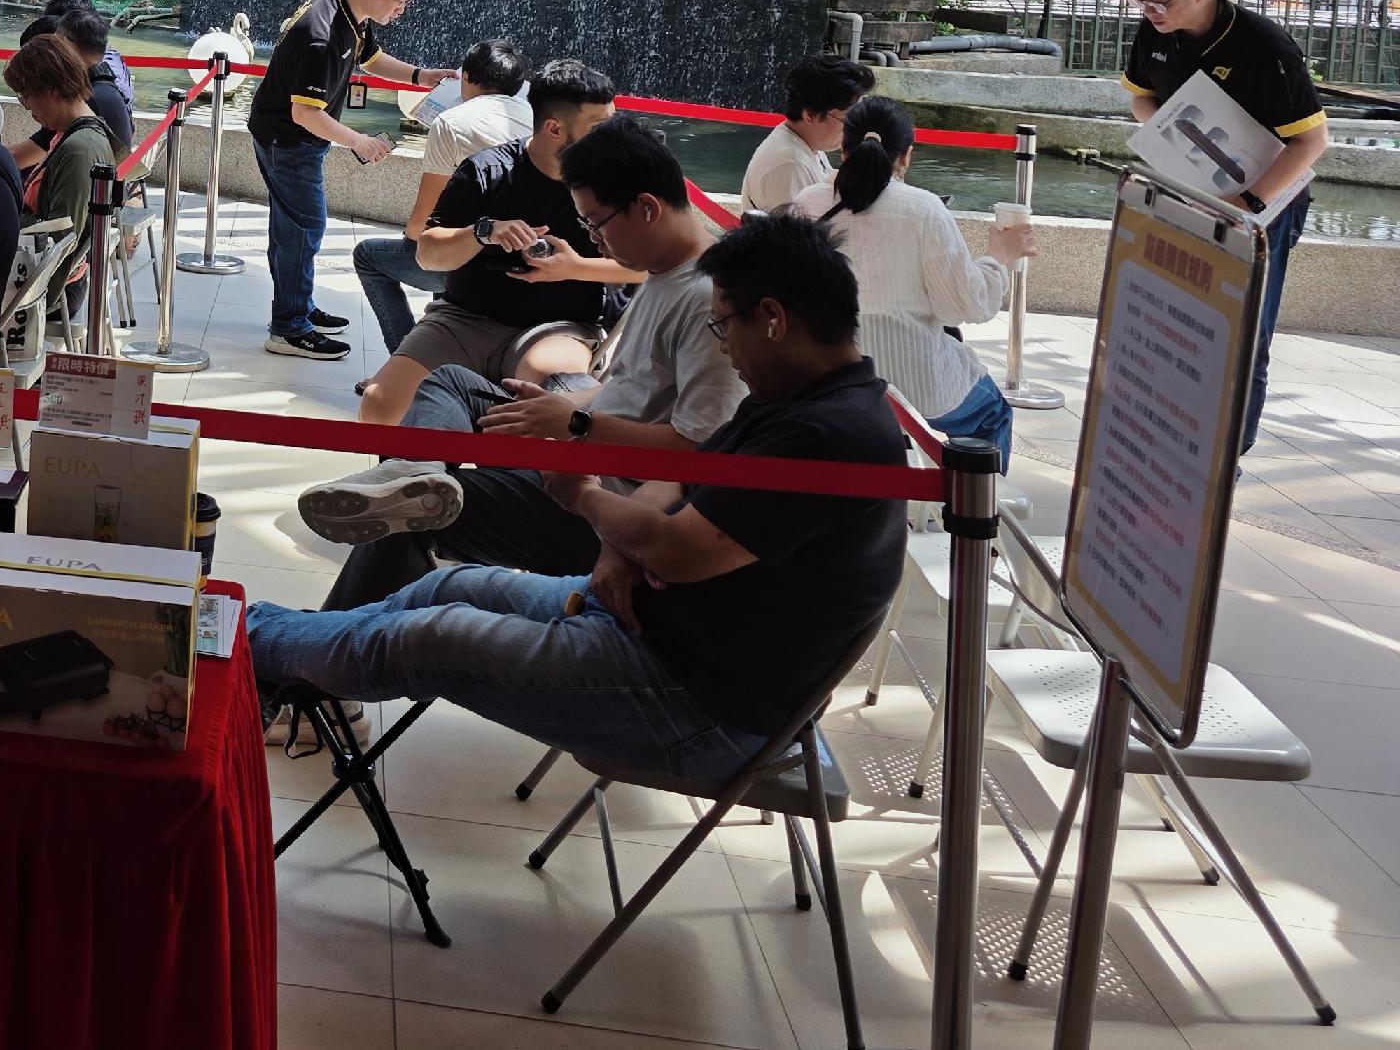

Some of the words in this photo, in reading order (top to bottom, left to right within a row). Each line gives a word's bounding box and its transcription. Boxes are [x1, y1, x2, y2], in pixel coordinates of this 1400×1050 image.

[6, 263, 29, 346] Rots
[57, 357, 110, 376] 限時特價
[43, 455, 102, 479] EUPA
[26, 555, 105, 572] EUPA
